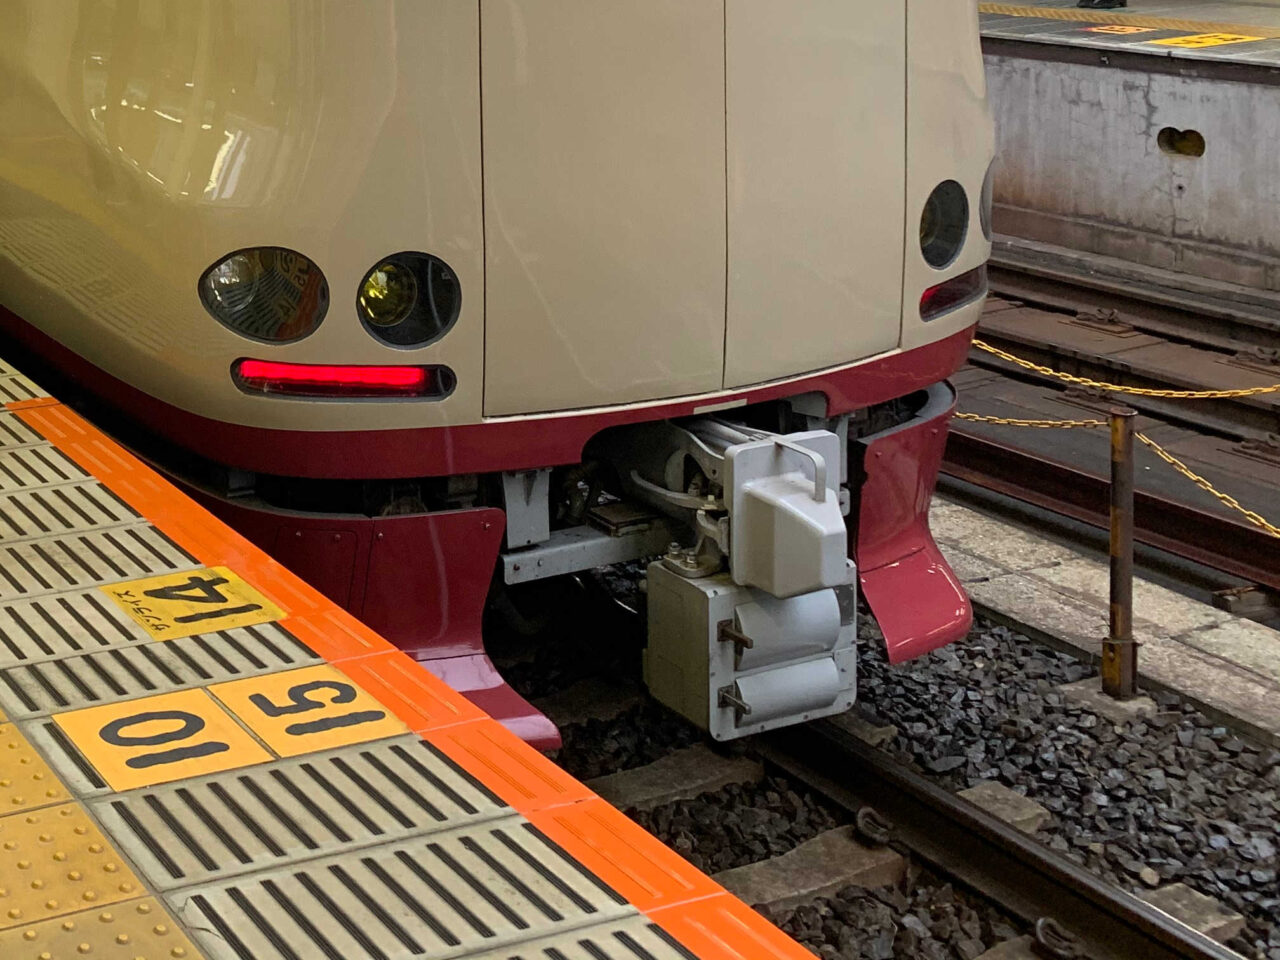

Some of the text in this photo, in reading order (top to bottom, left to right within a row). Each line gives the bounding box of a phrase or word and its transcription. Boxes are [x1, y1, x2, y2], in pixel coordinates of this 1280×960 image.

[143, 575, 264, 624] 14
[248, 679, 387, 736] 15
[98, 709, 231, 770] 10
